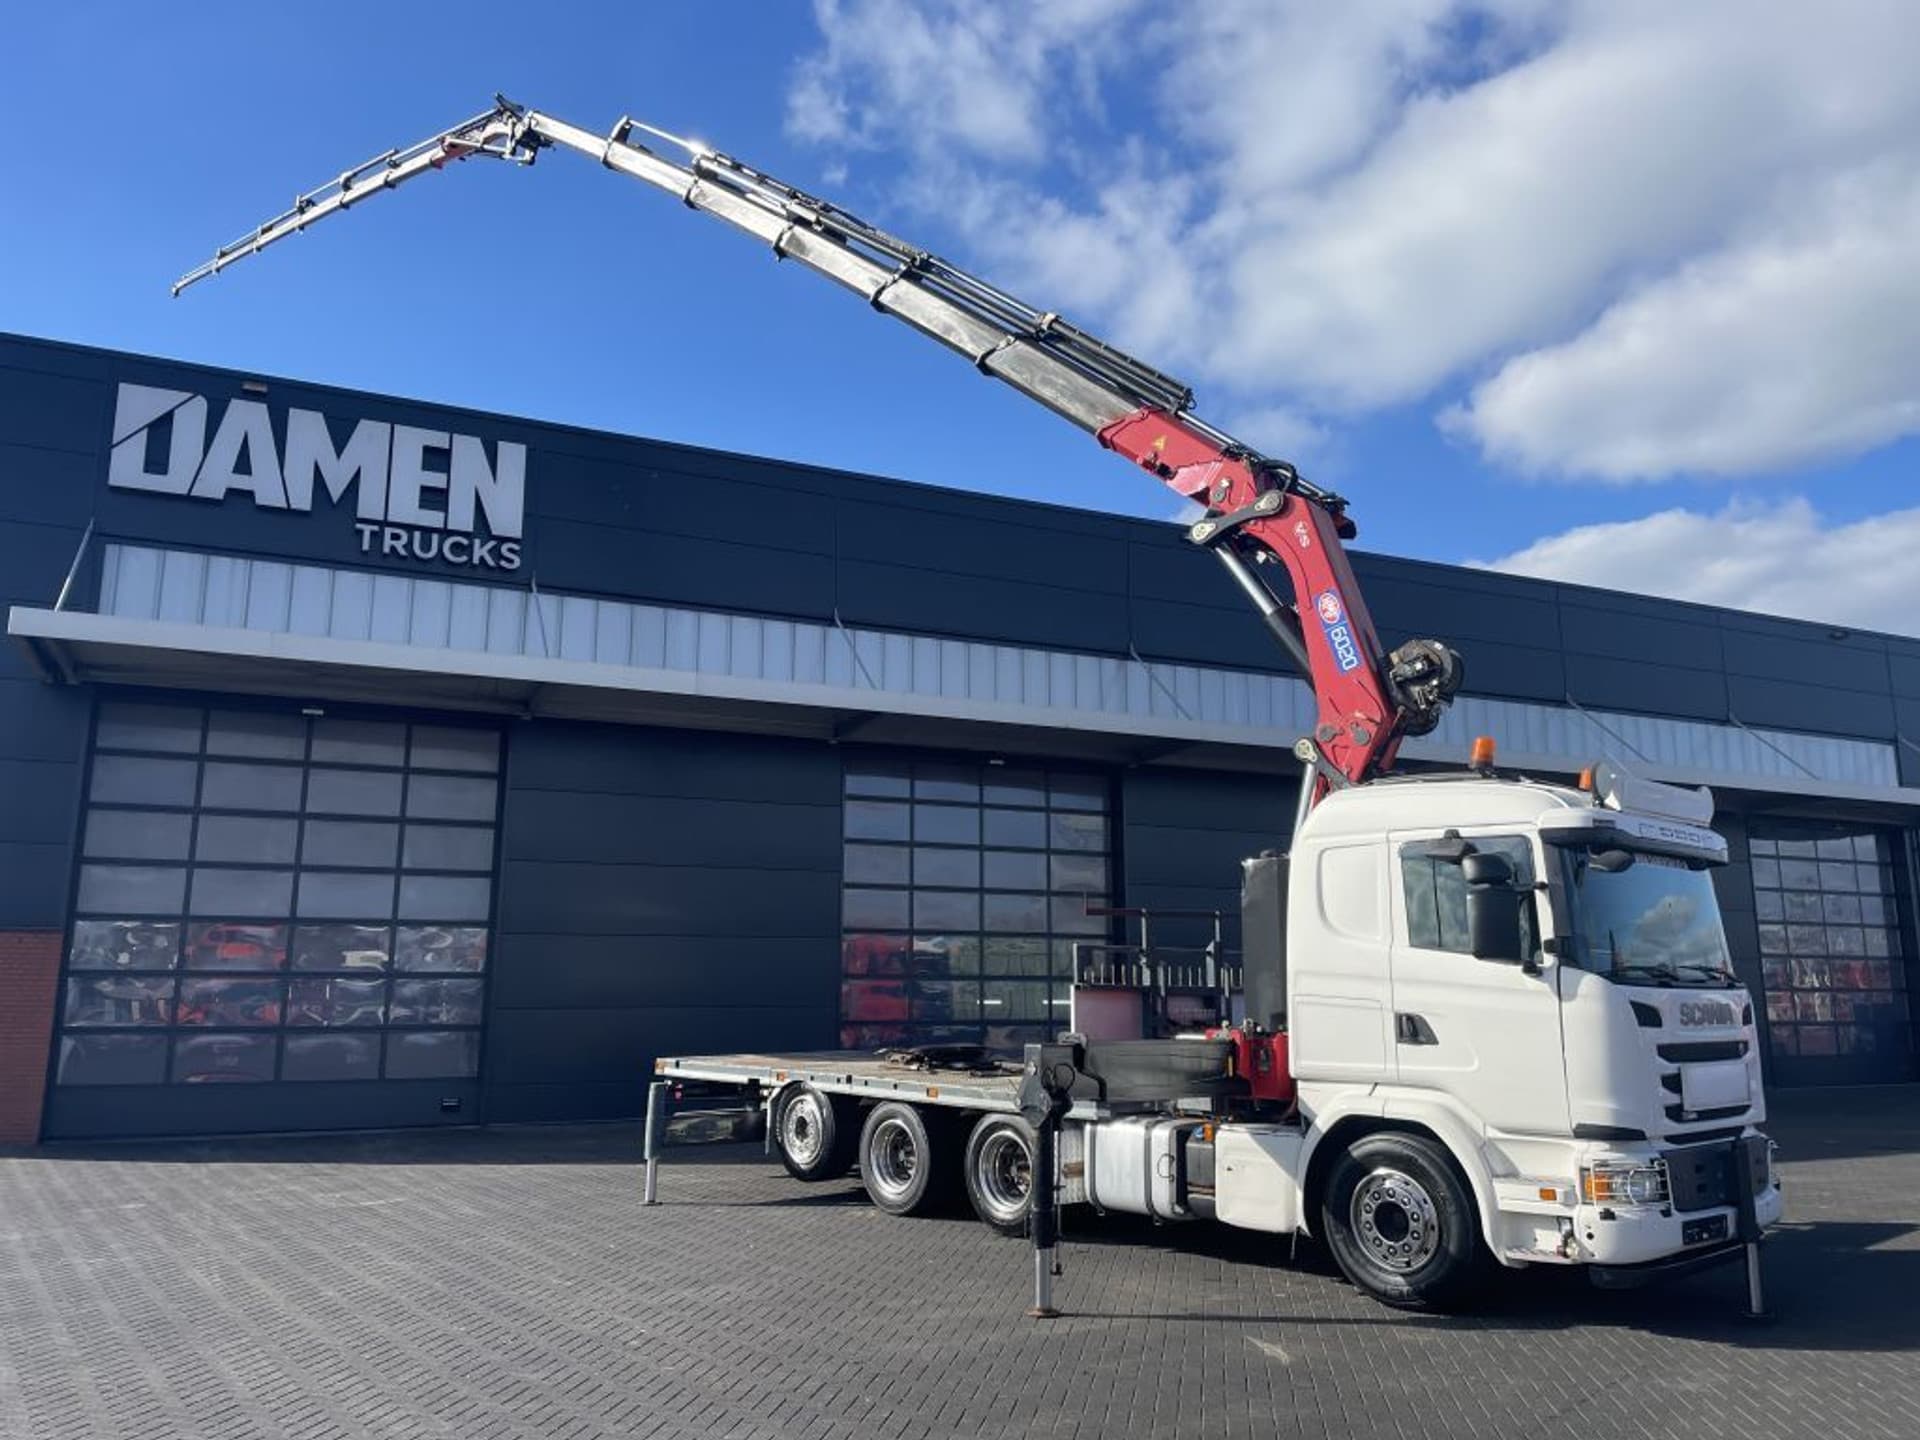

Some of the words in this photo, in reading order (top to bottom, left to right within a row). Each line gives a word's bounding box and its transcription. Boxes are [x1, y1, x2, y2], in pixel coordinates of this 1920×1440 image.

[108, 382, 526, 538] DAMEN
[355, 523, 521, 569] TRUCKS
[1331, 626, 1358, 671] 6020
